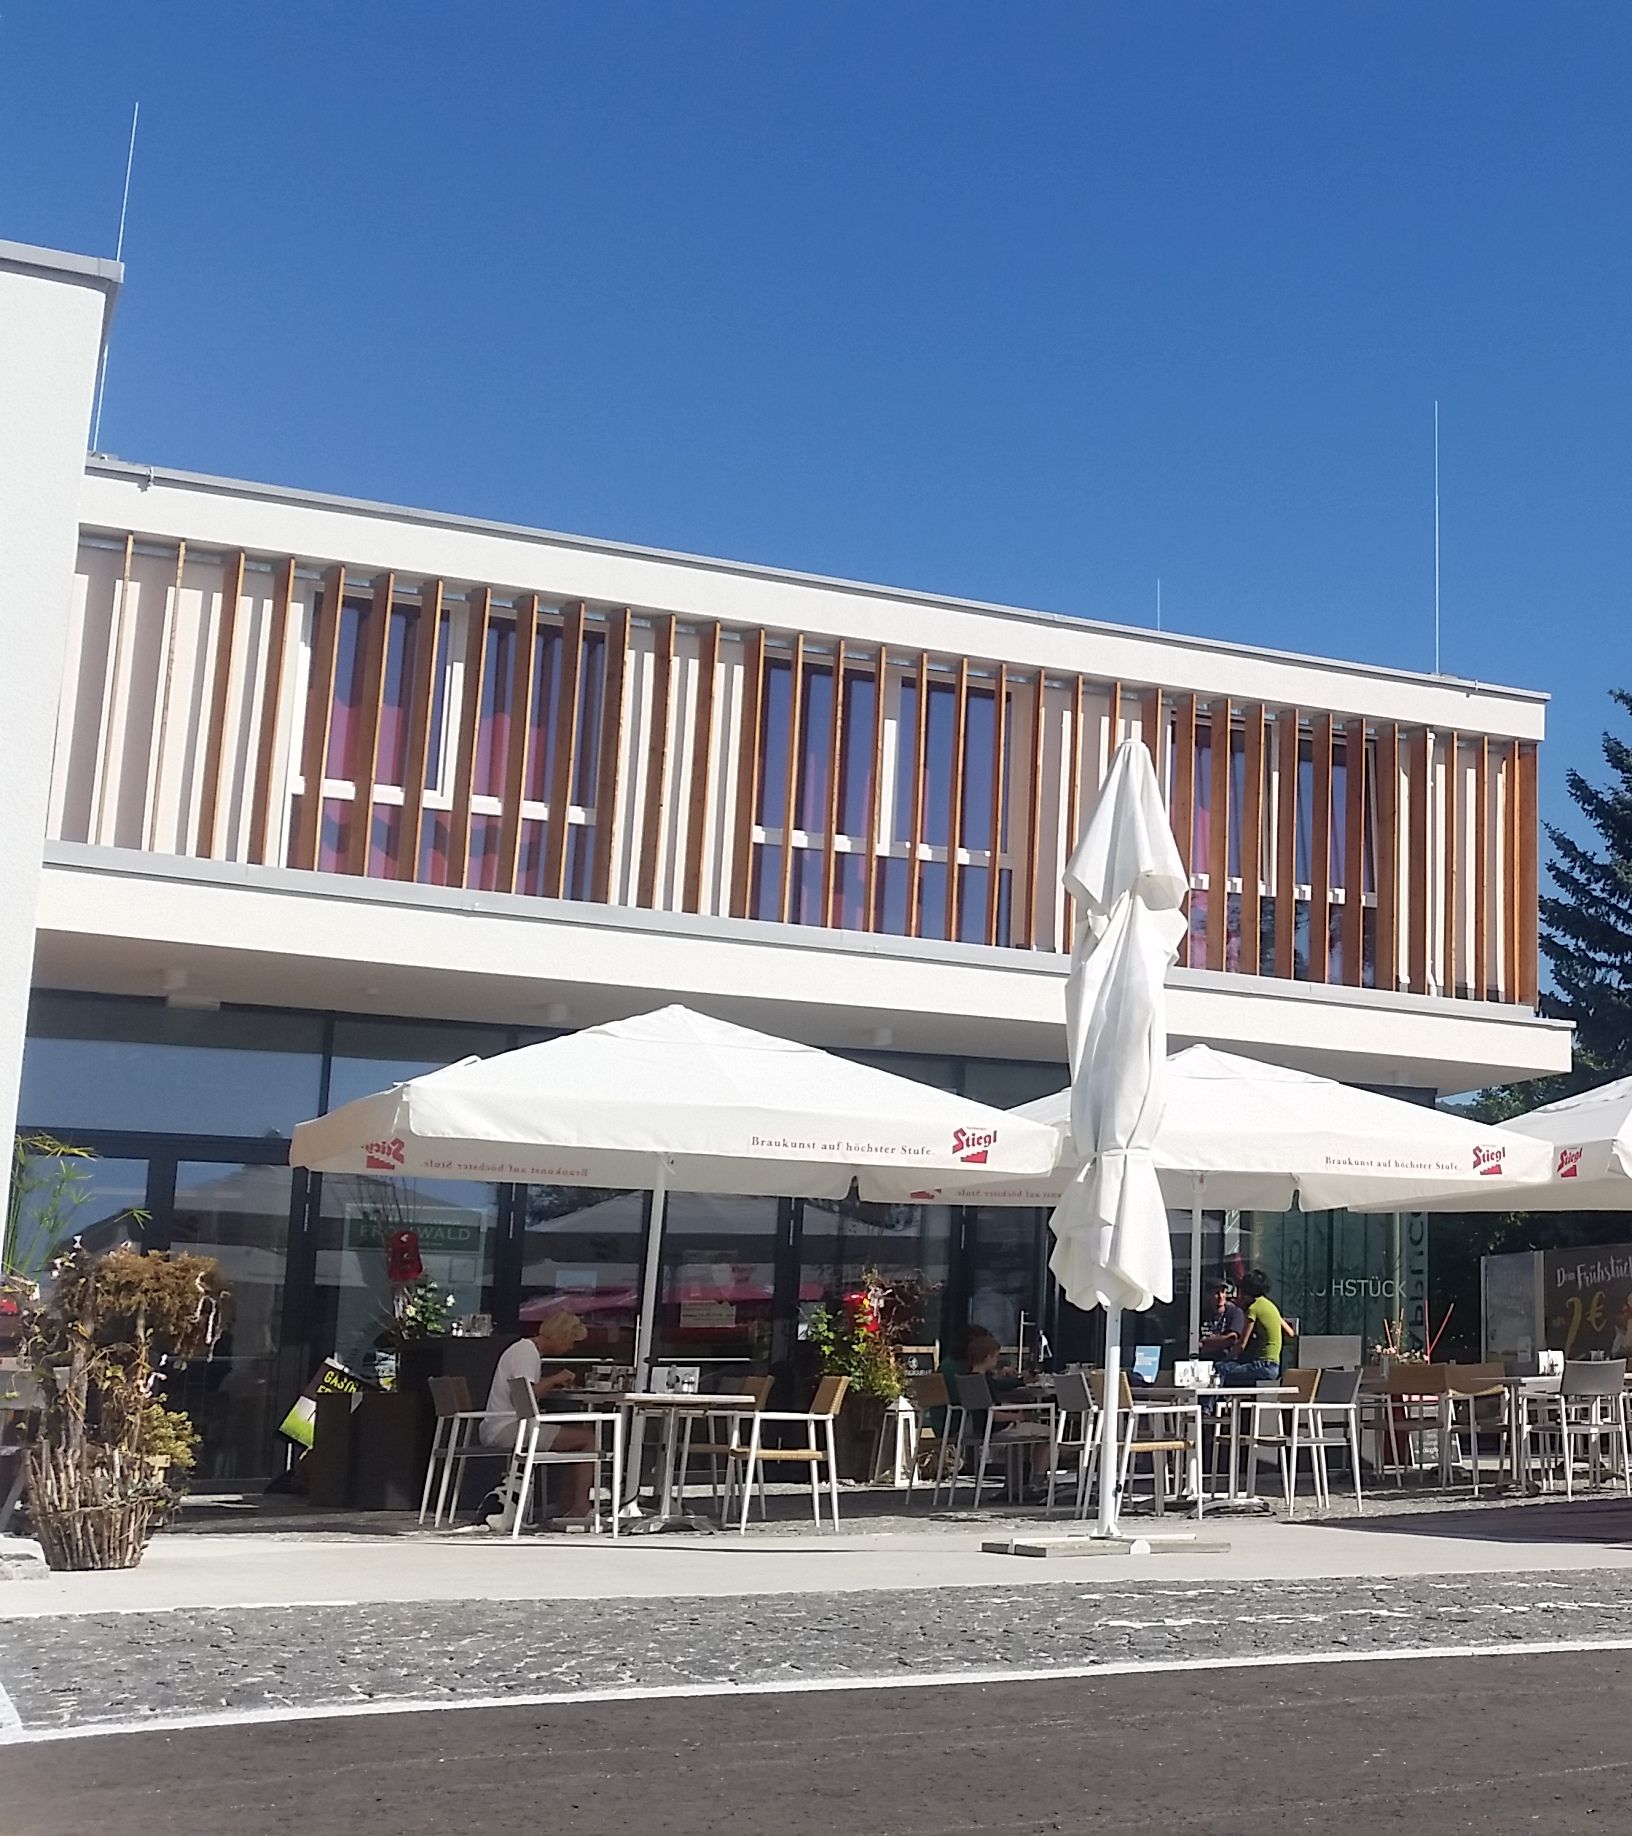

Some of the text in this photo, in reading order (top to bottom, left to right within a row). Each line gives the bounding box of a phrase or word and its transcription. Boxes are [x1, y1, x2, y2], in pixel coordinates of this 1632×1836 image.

[752, 1136, 816, 1149] Braukunst
[821, 1140, 843, 1151] auf
[846, 1142, 896, 1154] höchster
[952, 1127, 997, 1154] Stiegl
[1377, 1159, 1391, 1168] auf
[1473, 1145, 1506, 1169] Stiegl
[360, 1224, 472, 1241] FRWALD
[1302, 1275, 1407, 1298] HSTÜCK
